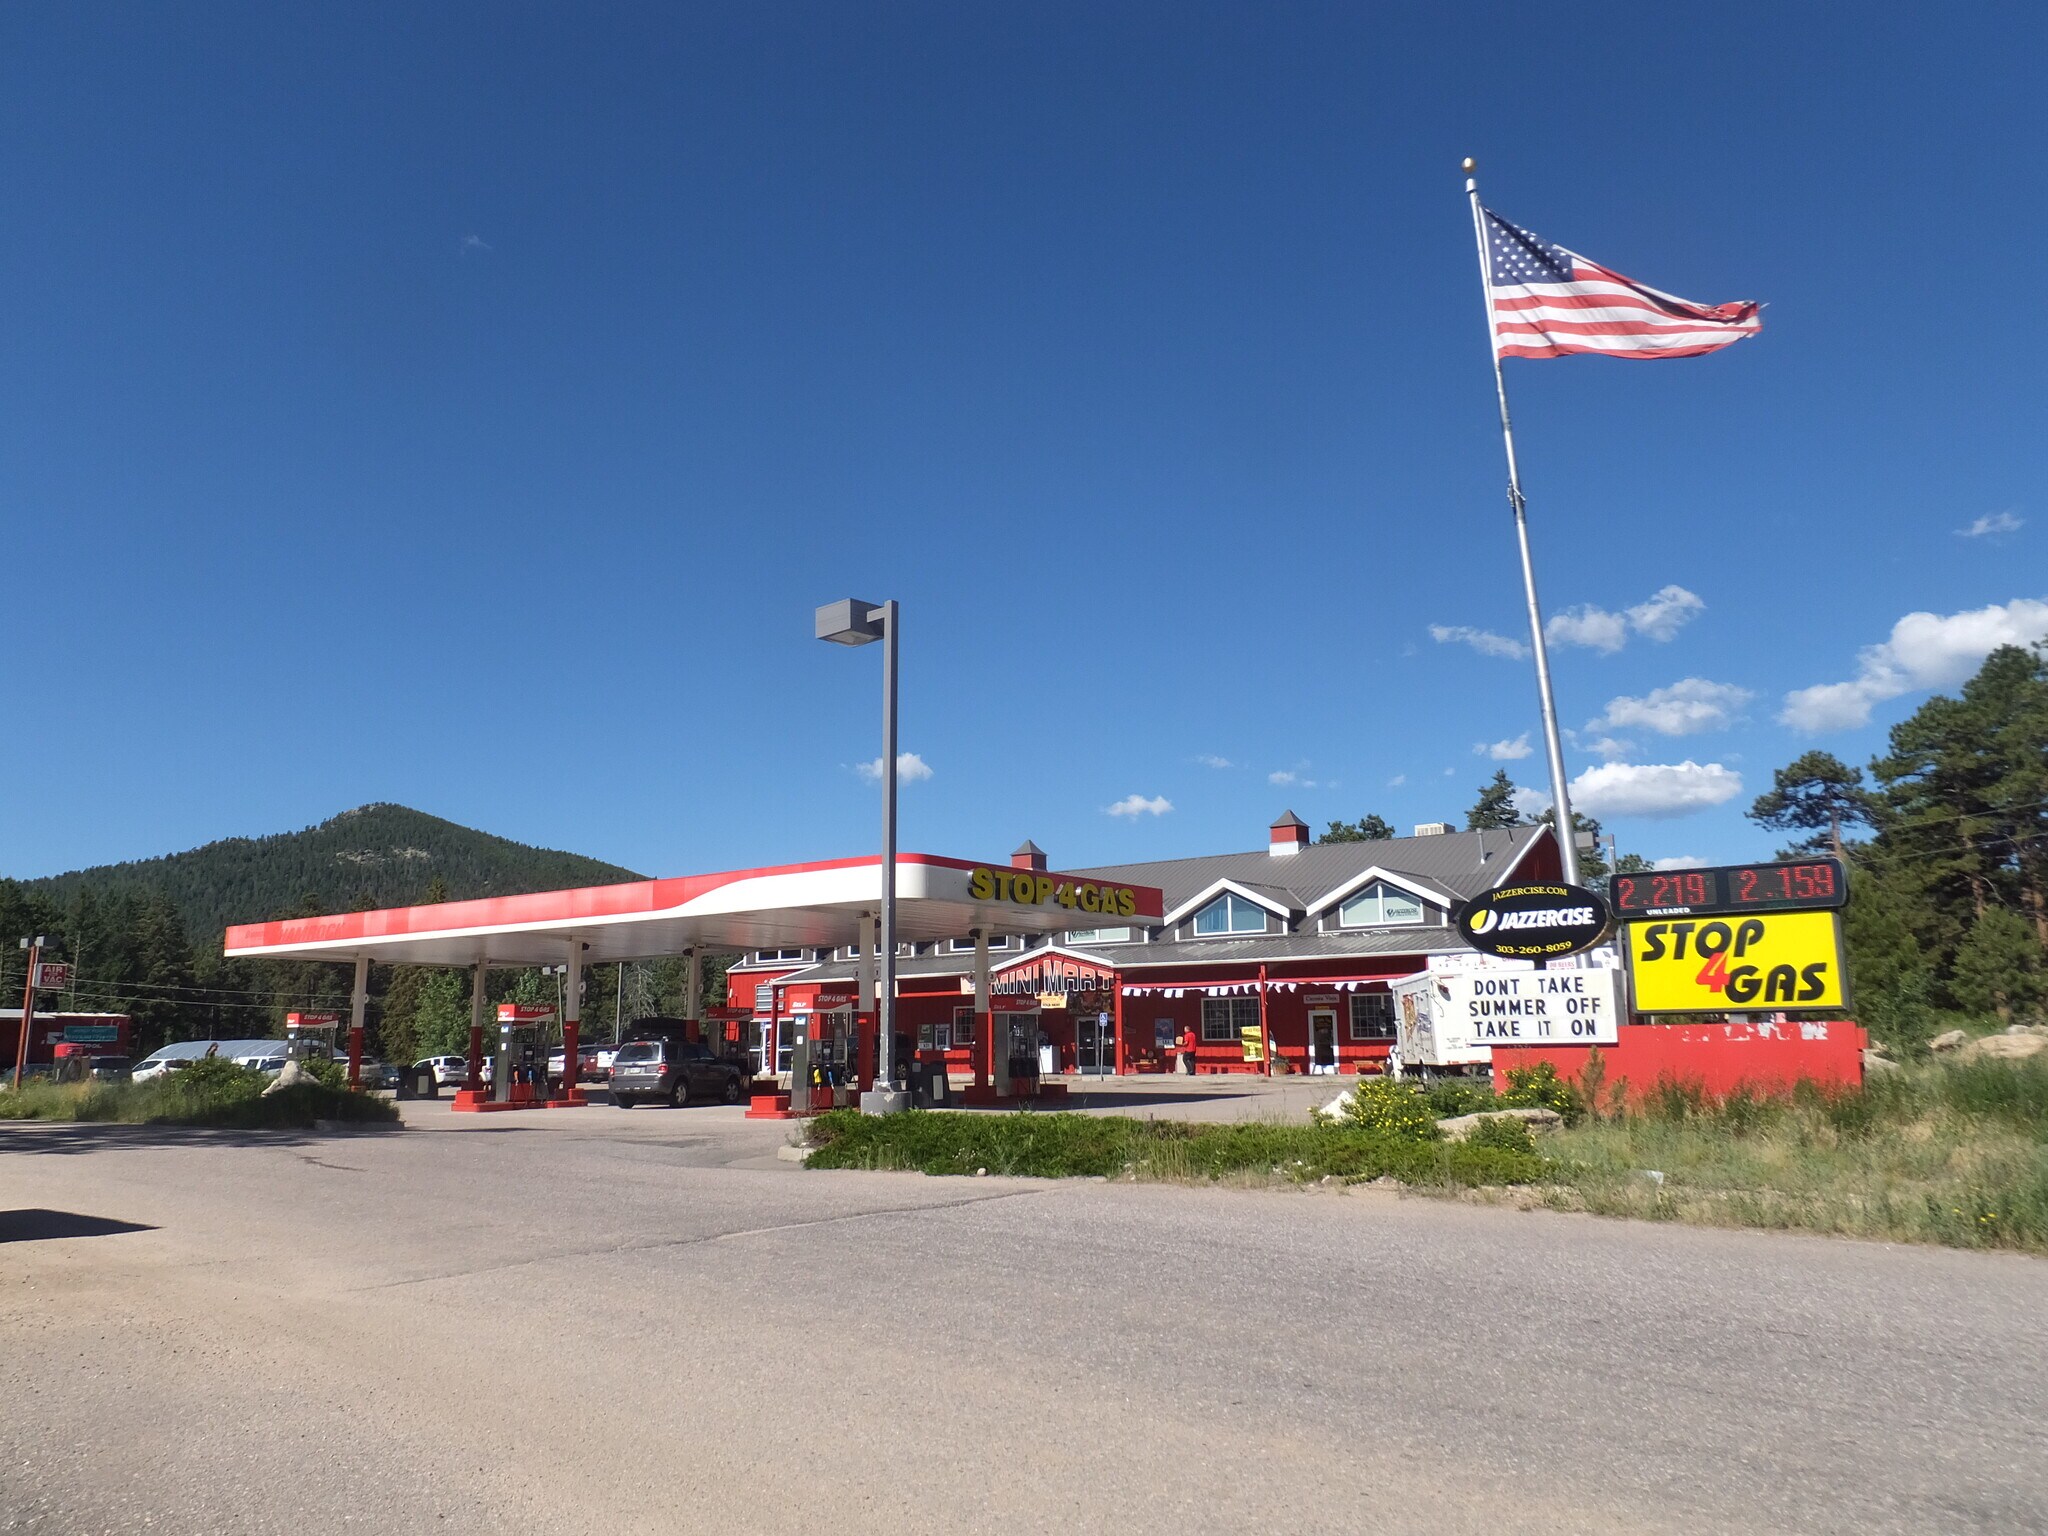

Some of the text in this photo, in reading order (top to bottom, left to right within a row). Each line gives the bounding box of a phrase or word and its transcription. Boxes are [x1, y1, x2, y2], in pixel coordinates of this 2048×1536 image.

[970, 867, 1136, 917] STOP 4 GAS
[1493, 886, 1568, 901] JAZZERCISE.COM
[1618, 874, 1706, 909] 2.219
[1739, 865, 1835, 901] 2.159
[1498, 907, 1594, 931] JAZZERCISE
[1646, 907, 1690, 915] UNLEADED
[1495, 941, 1572, 954] 303-260-8059
[1641, 919, 1764, 962] STOP
[991, 960, 1114, 995] MINI MART
[1474, 977, 1584, 996] DONT TAKE
[1695, 952, 1731, 993] 4
[1724, 962, 1827, 1003] GAS
[1469, 997, 1601, 1017] SUMMER OFF
[1474, 1019, 1596, 1037] TAKE IT ON
